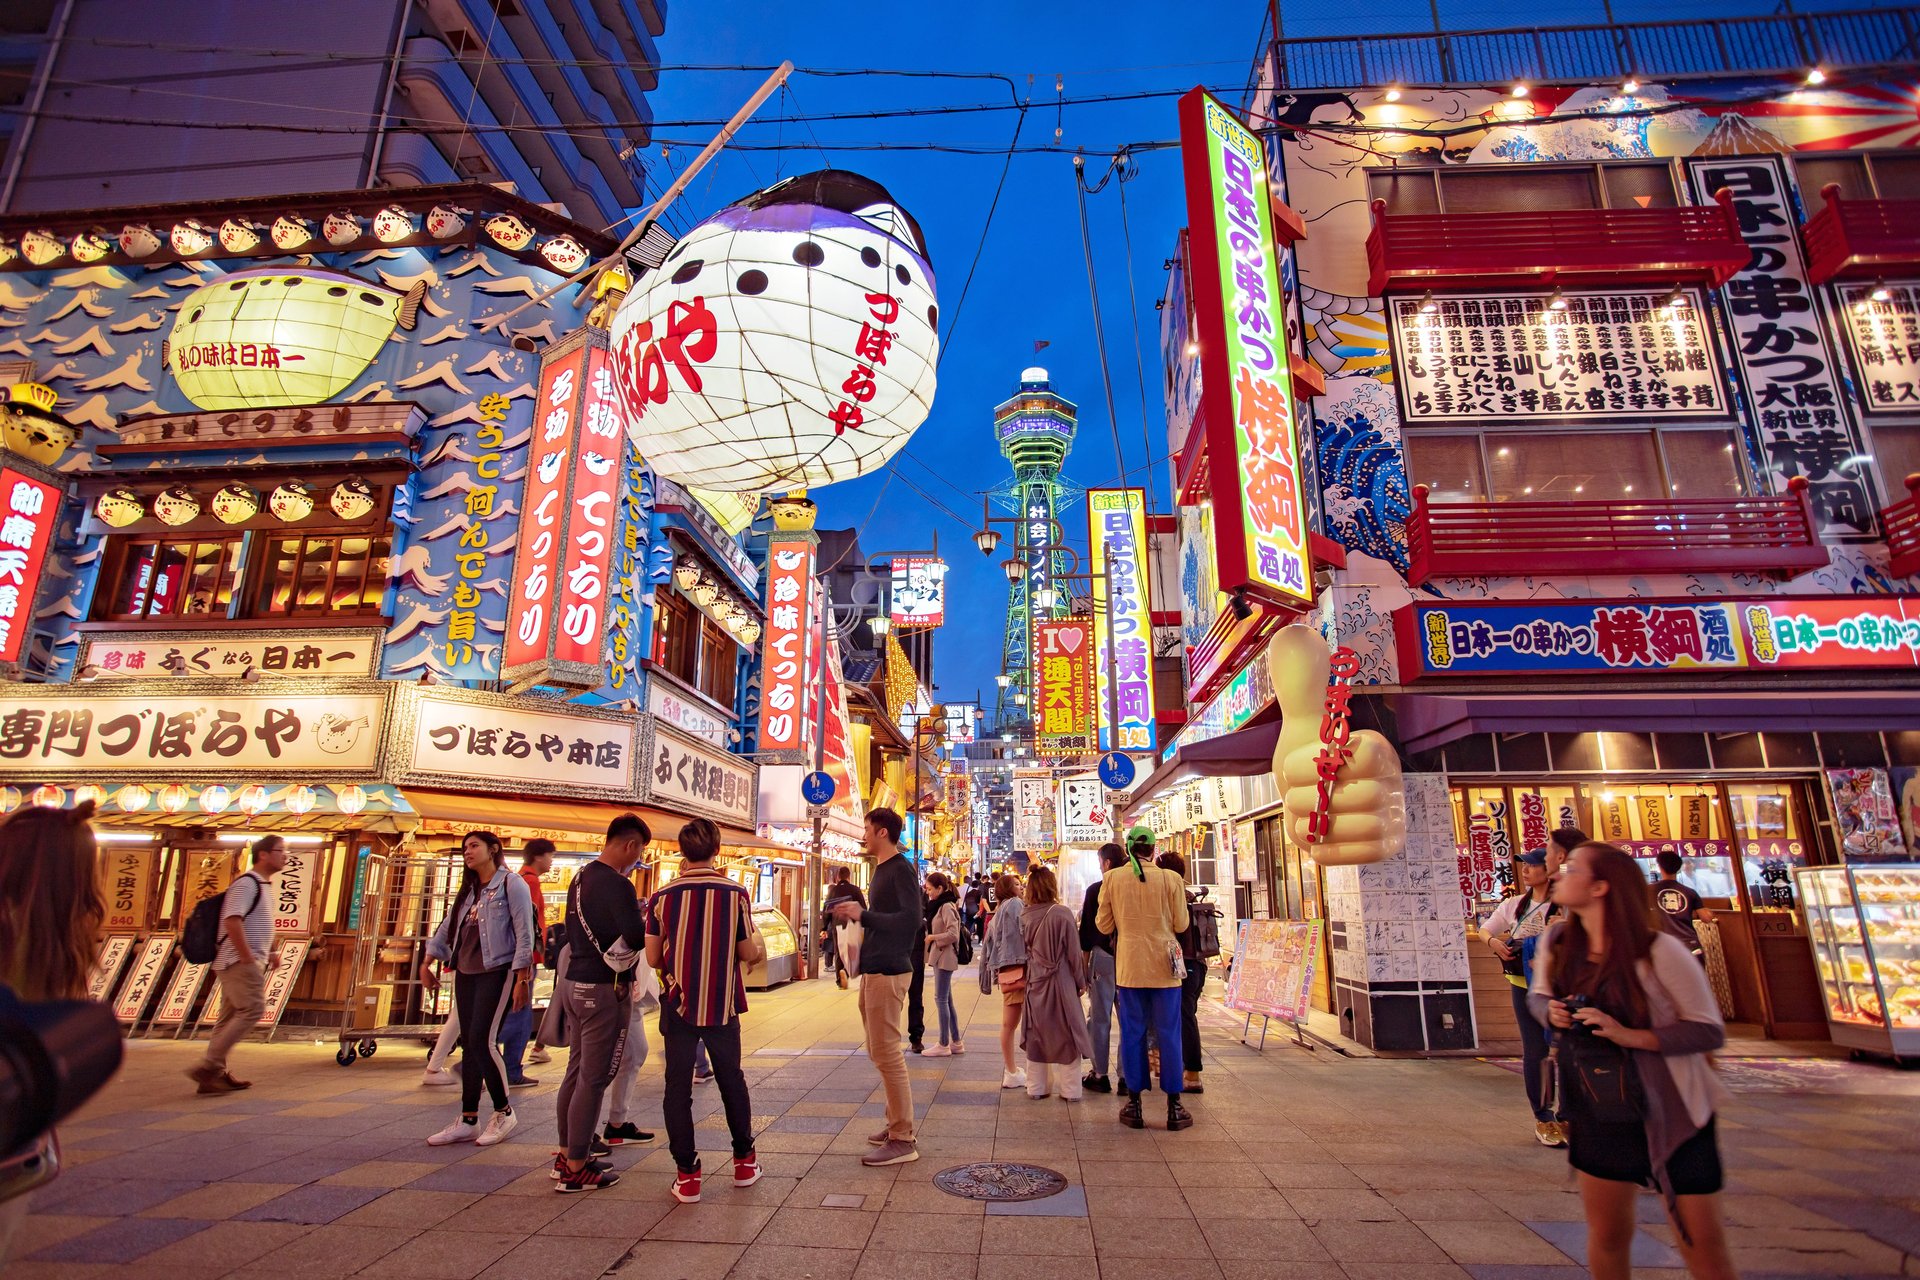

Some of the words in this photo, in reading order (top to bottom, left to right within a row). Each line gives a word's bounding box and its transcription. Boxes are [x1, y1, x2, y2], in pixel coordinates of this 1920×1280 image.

[1207, 104, 1260, 166] 新世界
[178, 343, 306, 371] 私の味は日本一
[828, 293, 904, 436] づぼらや
[1408, 356, 1432, 414] もち
[1430, 355, 1455, 413] うずら玉子
[1450, 355, 1477, 413] 紅しょうが
[1470, 355, 1496, 413] にんにく
[1492, 354, 1518, 412] 玉ねぎ
[1513, 353, 1540, 412] 山芋
[1535, 353, 1563, 411] しし唐
[1556, 352, 1585, 411] れんこん
[1577, 351, 1605, 410] 銀杏
[1600, 351, 1627, 410] 白ねぎ
[1621, 350, 1649, 410] さつま芋
[1642, 350, 1671, 409] じゃが芋
[1663, 350, 1692, 408] 茄子
[1685, 349, 1715, 408] 椎茸
[1755, 382, 1836, 410] 大阪
[1760, 408, 1841, 429] 新世界
[1235, 366, 1302, 546] 横綱
[1094, 493, 1138, 511] 新世界
[1255, 541, 1304, 592] 酒処
[102, 651, 145, 669] 珍味
[1425, 612, 1452, 667] 新世界
[1449, 621, 1594, 657] 日本一の串かつ
[1594, 608, 1699, 666] 横綱
[1699, 608, 1736, 664] 酒処
[1749, 607, 1771, 662] 新世界
[1042, 656, 1073, 734] 通天閣
[1073, 656, 1085, 733] TSUTENKAKU
[429, 724, 624, 770] づぼらや本店
[654, 744, 750, 813] ふぐ料理専門
[1490, 801, 1508, 859] ソースの
[1645, 799, 1663, 837] にんにく
[1689, 799, 1702, 836] 玉ねぎ
[110, 916, 134, 926] 840
[1762, 920, 1788, 932] 入口
